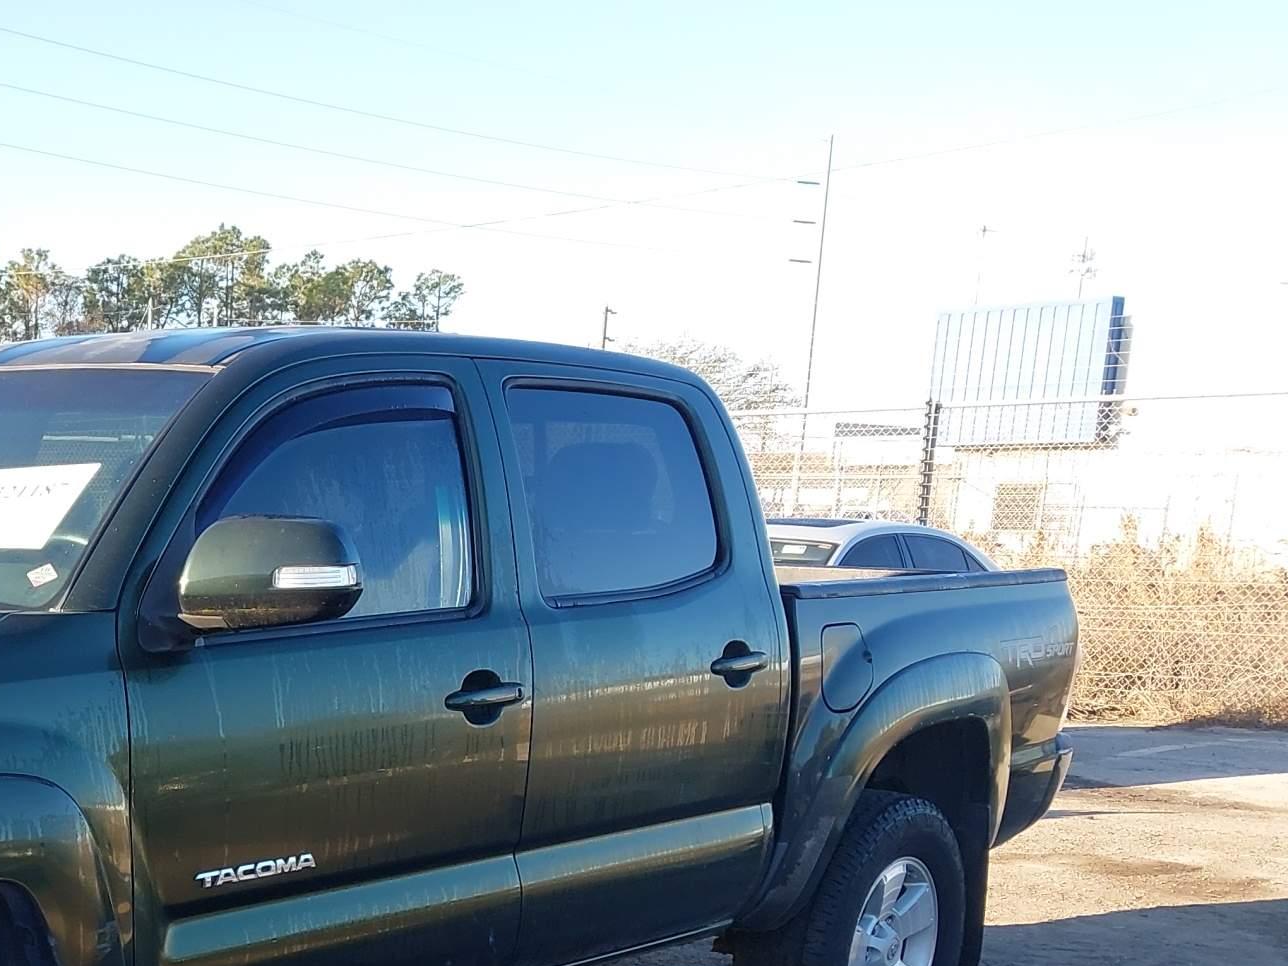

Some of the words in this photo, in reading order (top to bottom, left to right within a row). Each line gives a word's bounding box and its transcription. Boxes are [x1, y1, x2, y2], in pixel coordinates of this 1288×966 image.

[999, 636, 1045, 668] TRD
[1046, 641, 1074, 658] SPORT
[194, 852, 317, 889] TACOMA
